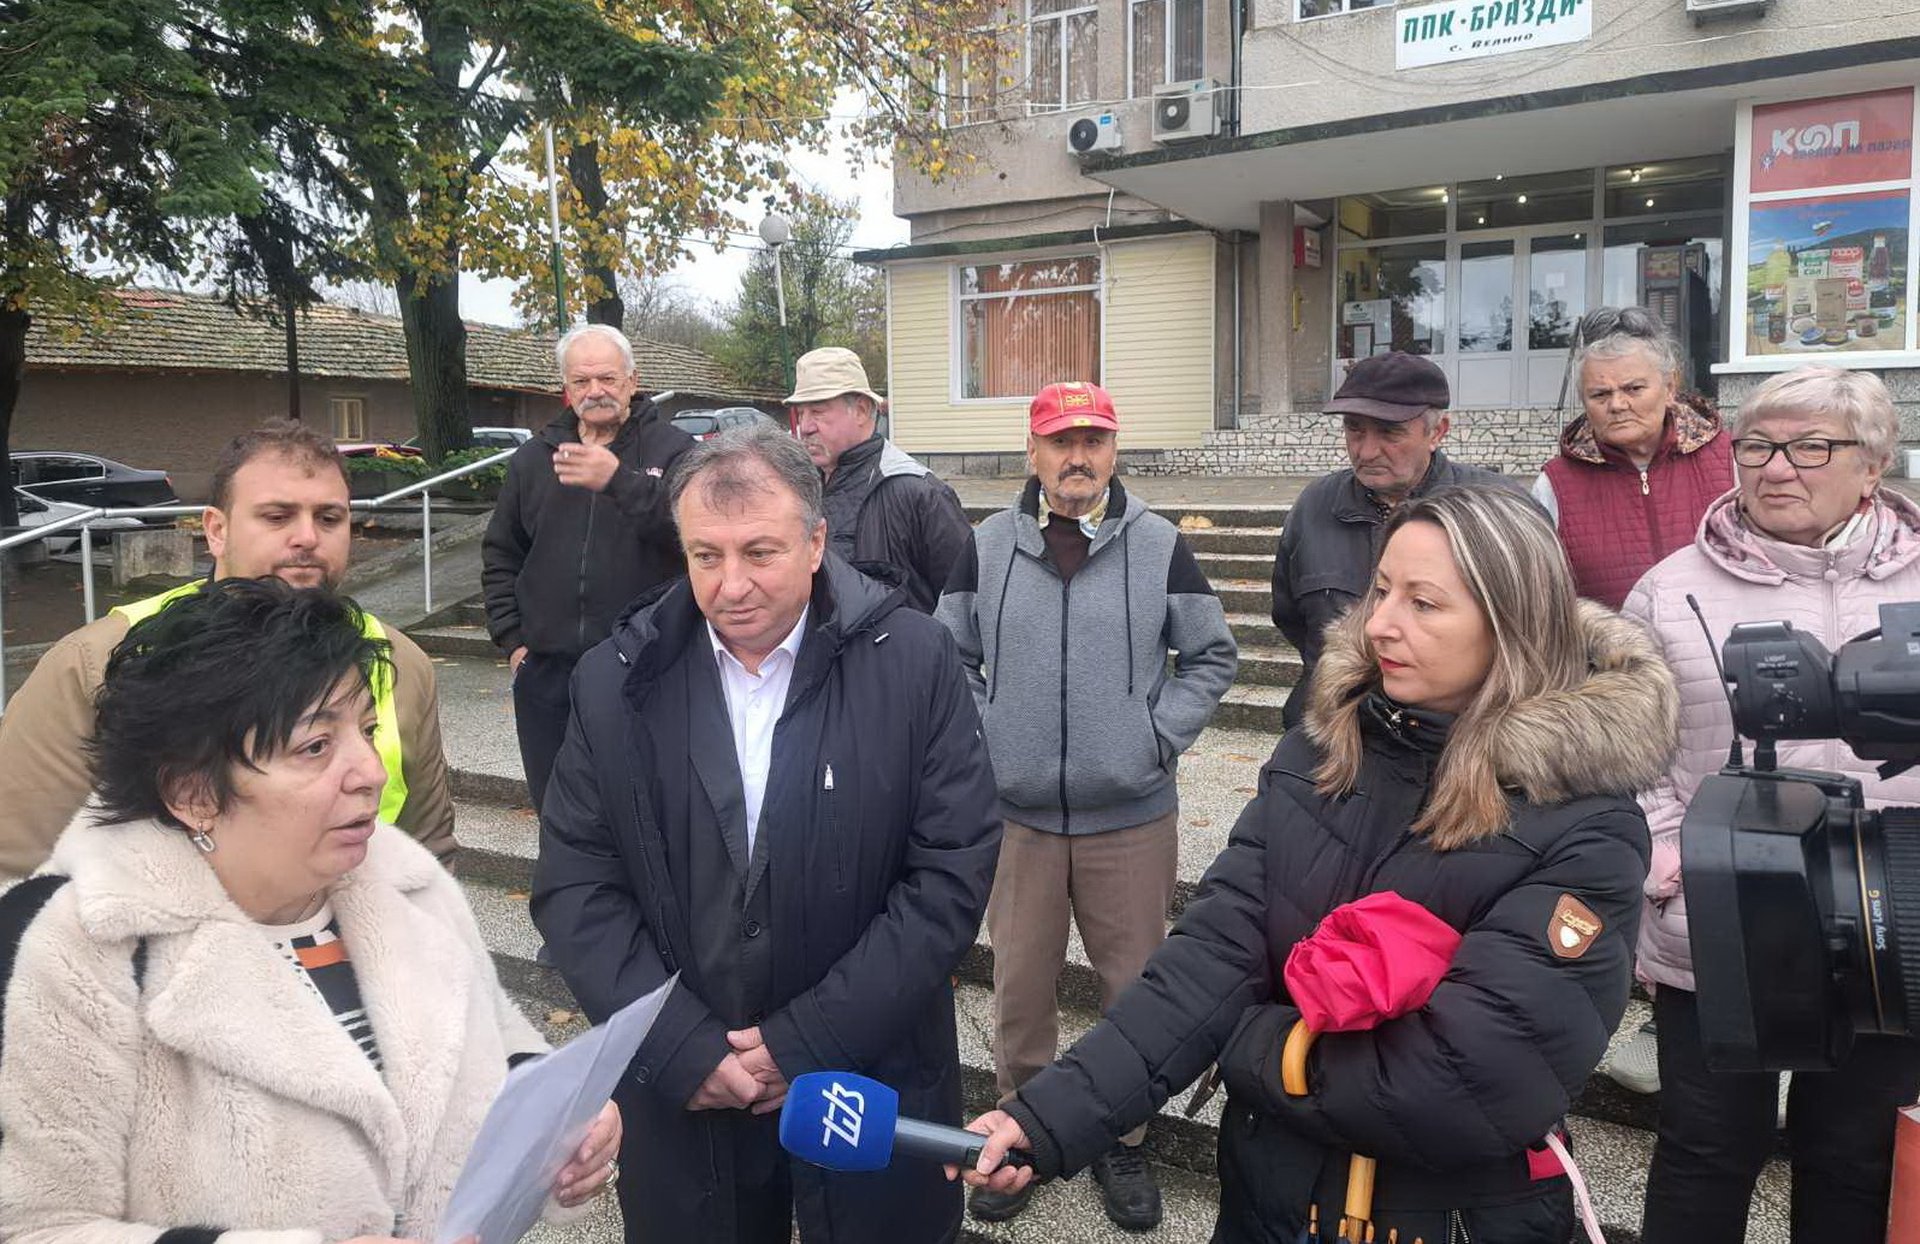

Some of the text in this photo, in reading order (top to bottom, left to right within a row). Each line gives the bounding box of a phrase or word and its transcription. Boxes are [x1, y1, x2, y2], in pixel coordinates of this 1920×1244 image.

[1403, 10, 1456, 44] ППК
[1868, 889, 1887, 951] Sony Lens G
